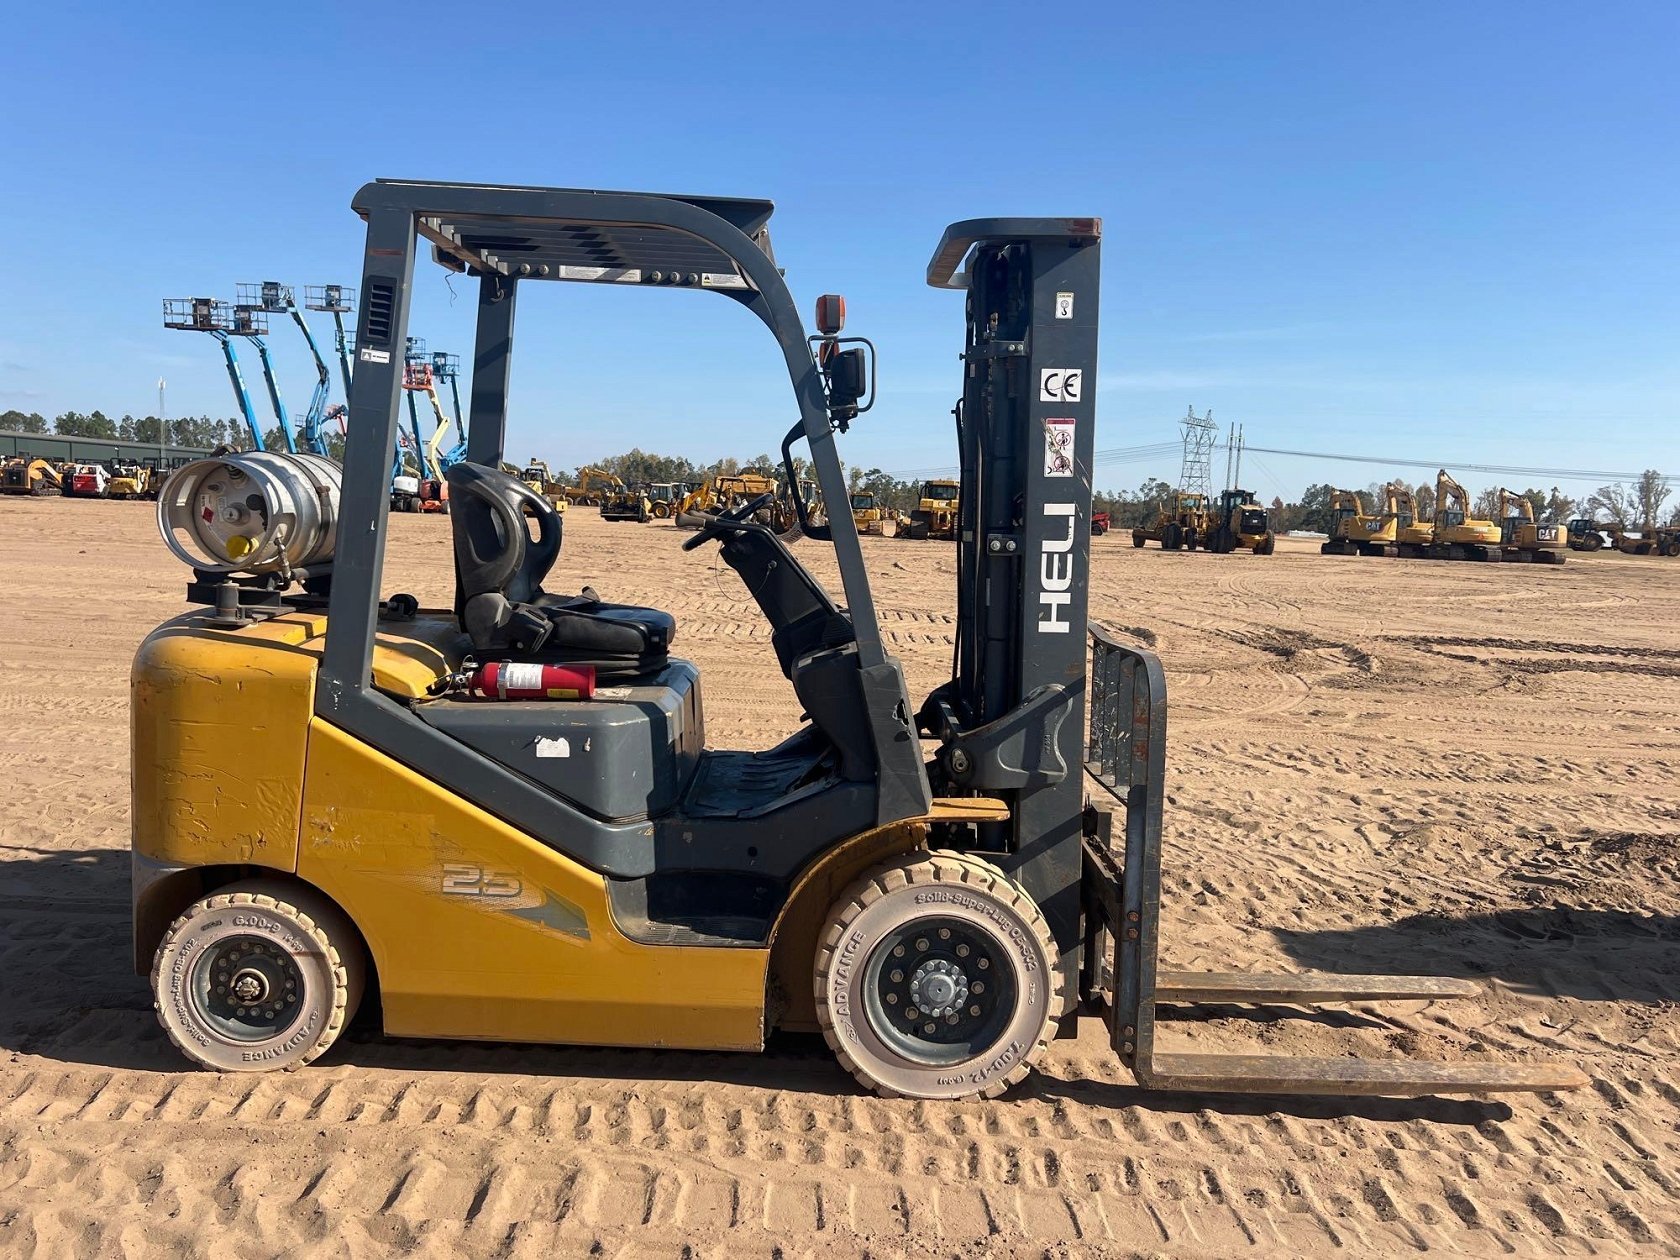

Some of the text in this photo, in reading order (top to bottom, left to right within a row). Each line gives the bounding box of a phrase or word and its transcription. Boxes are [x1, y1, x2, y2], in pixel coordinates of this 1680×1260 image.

[1044, 372, 1078, 398] CE
[1365, 521, 1381, 532] CAT
[1538, 528, 1557, 541] CAT
[1038, 503, 1076, 633] HELI
[442, 863, 523, 898] 25
[233, 915, 281, 934] 6.00-9
[834, 930, 867, 1016] ADVANCE
[242, 1025, 310, 1061] ADVANCE
